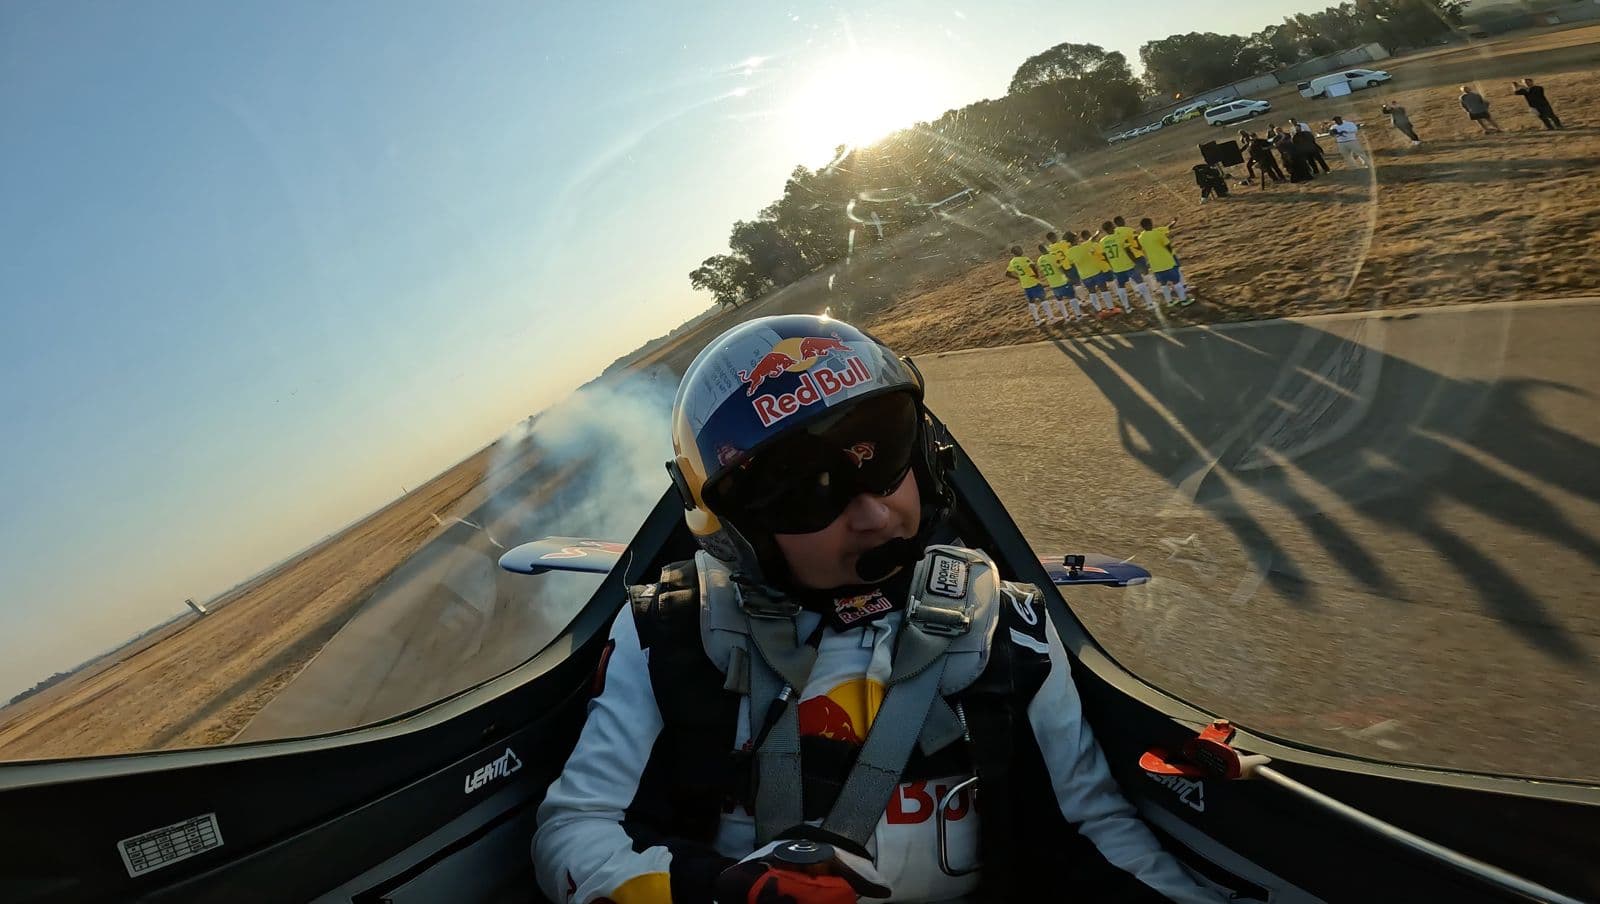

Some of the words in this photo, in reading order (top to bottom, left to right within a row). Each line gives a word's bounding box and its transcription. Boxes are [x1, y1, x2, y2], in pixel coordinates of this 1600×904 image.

[1105, 244, 1118, 258] 37
[753, 374, 821, 427] Red
[815, 357, 872, 398] Bull
[936, 560, 952, 593] HOOKER
[837, 606, 864, 623] Red
[863, 597, 893, 614] Bull
